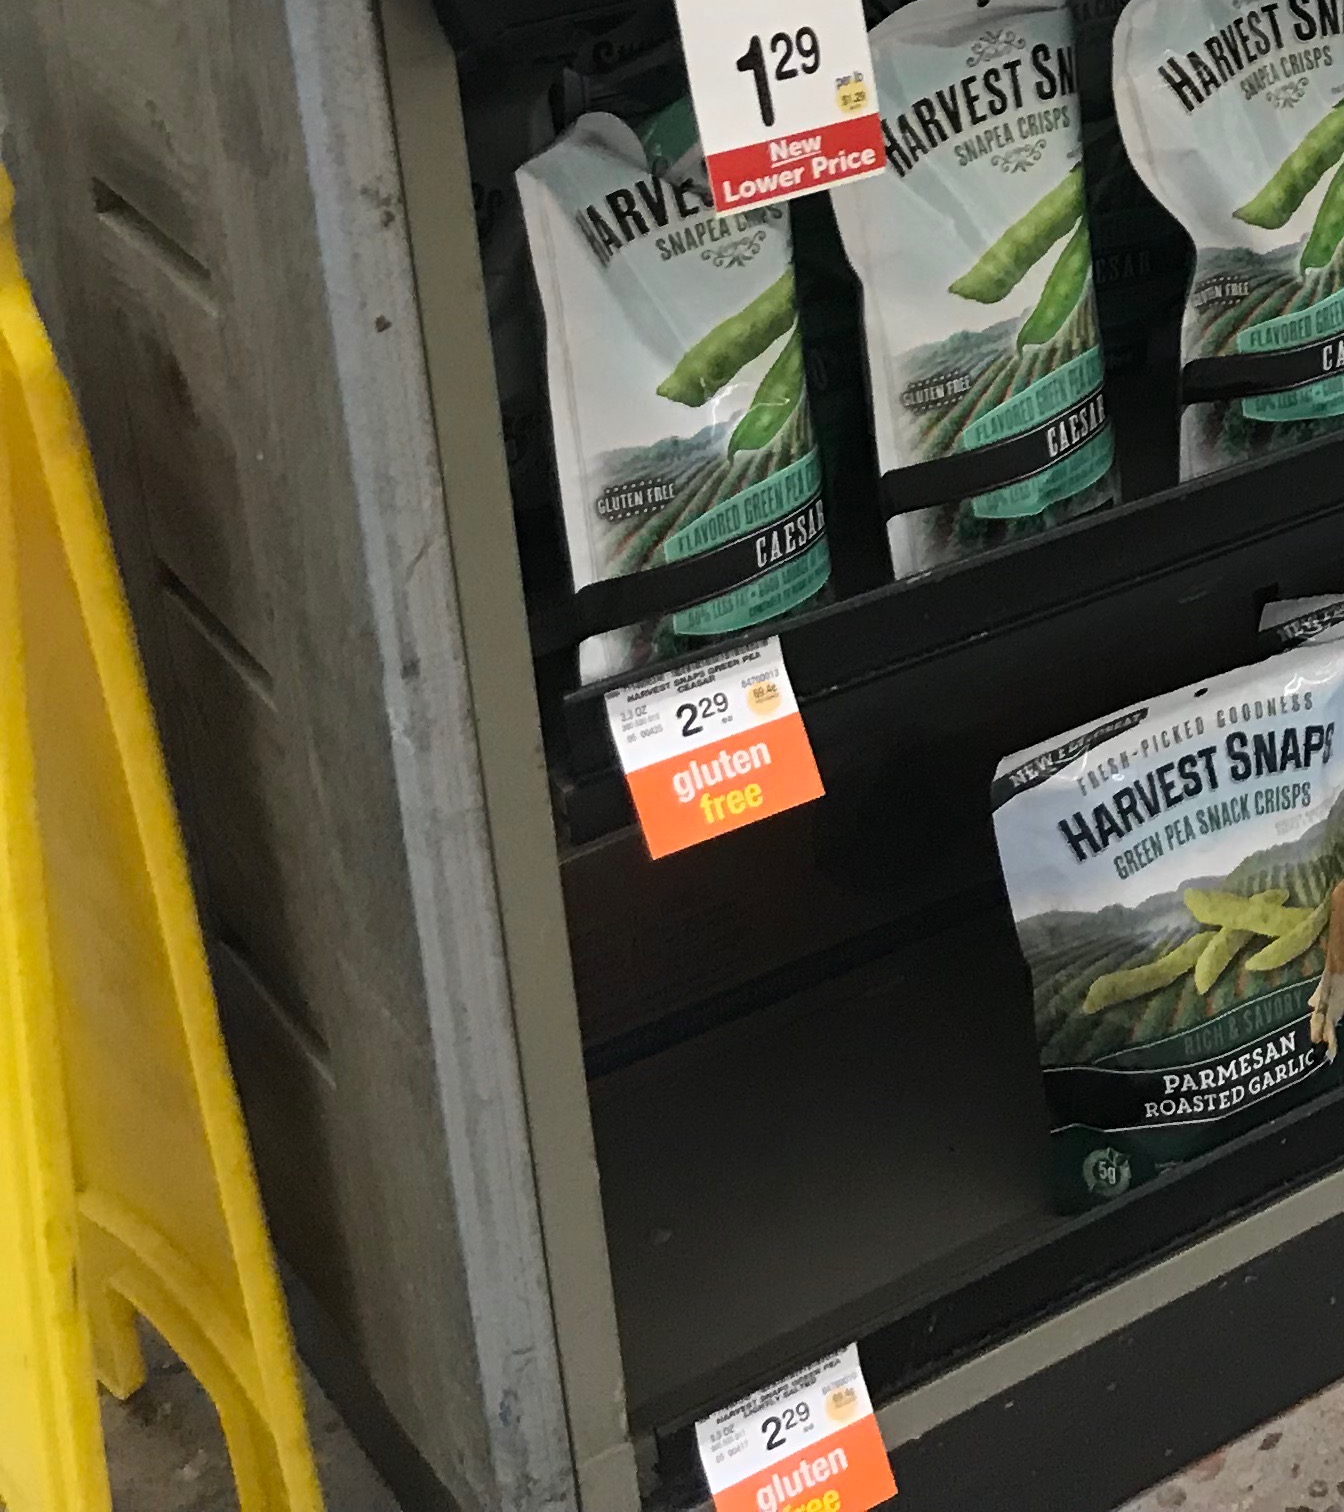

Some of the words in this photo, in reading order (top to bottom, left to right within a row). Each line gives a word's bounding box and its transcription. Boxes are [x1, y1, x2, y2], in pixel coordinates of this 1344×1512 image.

[1155, 0, 1282, 116] HARVEST
[1279, 44, 1334, 79] CRISPS
[769, 134, 823, 162] New
[880, 57, 1024, 179] HARVEST
[953, 120, 1015, 168] SNAPEA
[1016, 103, 1072, 144] CRISPS
[723, 165, 806, 203] Lower
[811, 146, 876, 180] Price
[655, 219, 732, 262] SNAPEA
[1046, 392, 1107, 460] CAESAR
[597, 488, 645, 516] GLUTEN
[678, 503, 741, 554] FLAVORED
[755, 498, 826, 569] CAESAR
[627, 682, 671, 703] HARVEST
[1217, 691, 1315, 730] GOODNESS
[672, 741, 773, 804] gluten
[700, 782, 764, 824] free
[1058, 745, 1218, 864] HARVEST
[1226, 720, 1336, 783] SNAPS
[1114, 839, 1162, 881] GREEN
[1164, 815, 1197, 854] PEA
[1198, 797, 1252, 836] SNACK
[1253, 781, 1312, 816] CRISPS
[1144, 1085, 1245, 1120] ROASTED
[1247, 1046, 1317, 1097] GARLIC
[1162, 1029, 1297, 1096] PARMESAN
[756, 1446, 849, 1512] gluten
